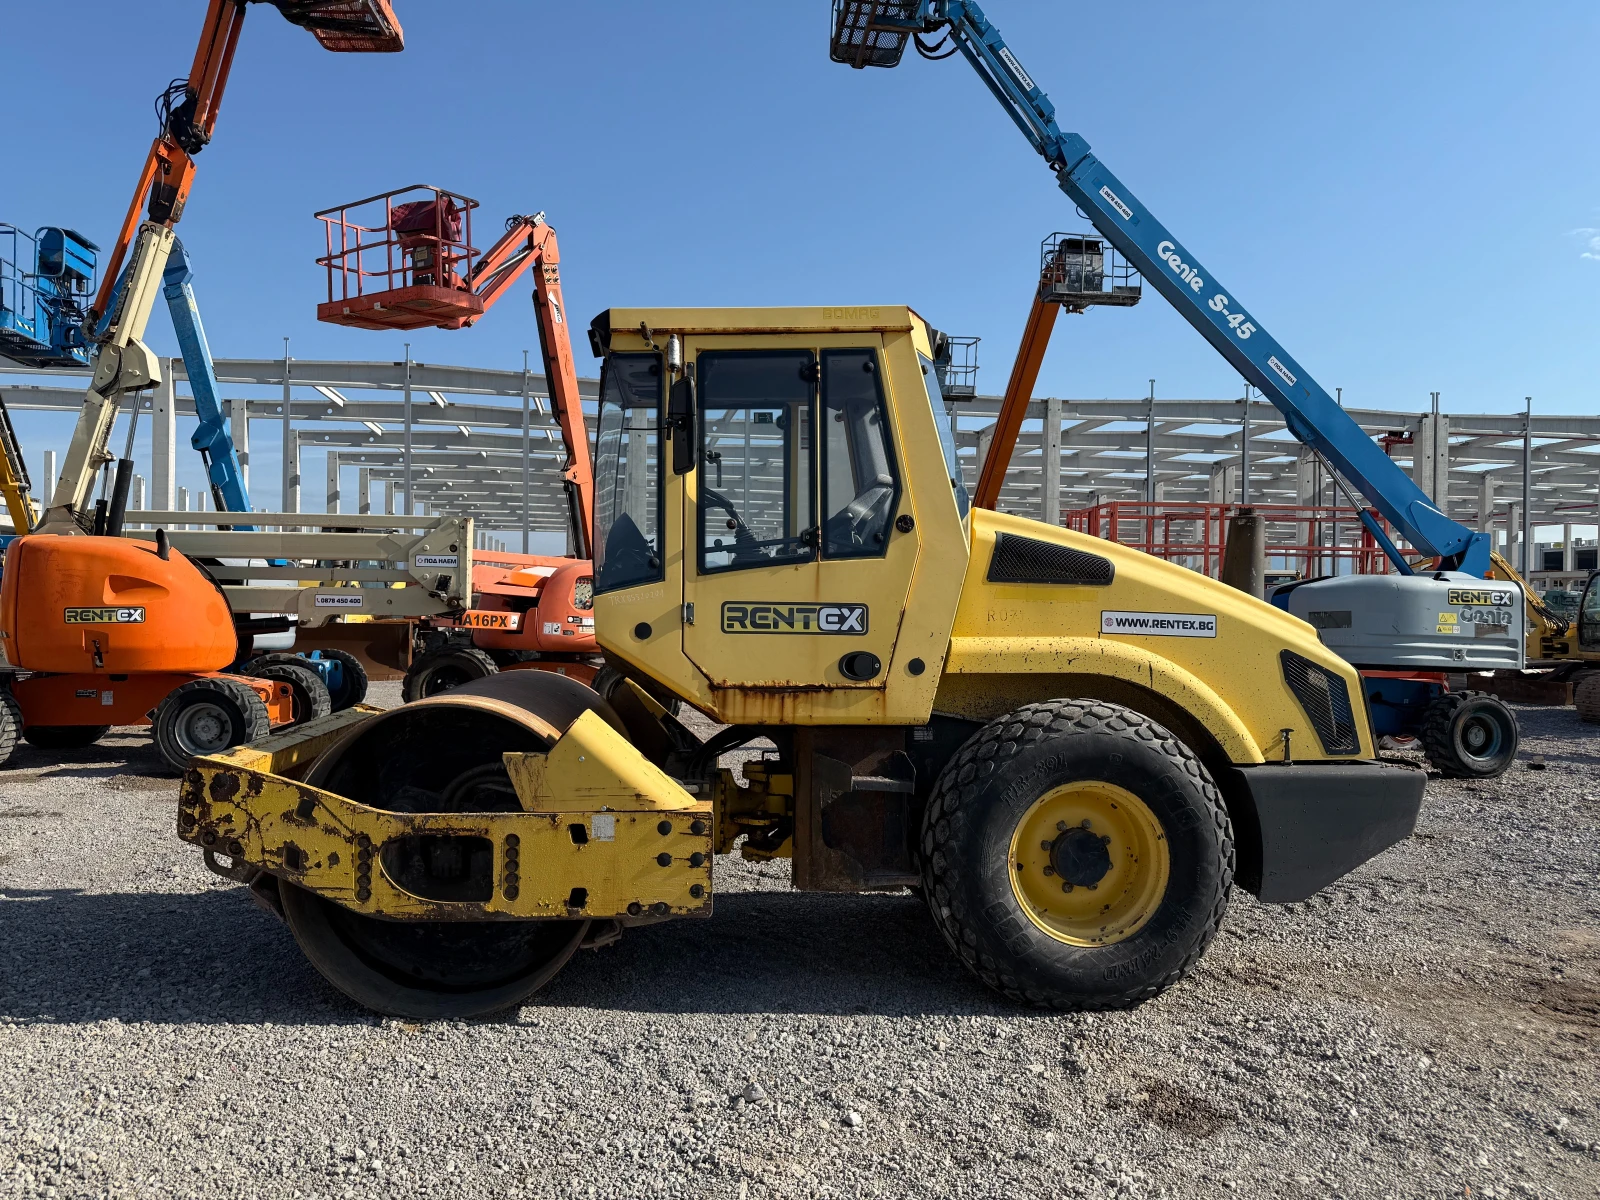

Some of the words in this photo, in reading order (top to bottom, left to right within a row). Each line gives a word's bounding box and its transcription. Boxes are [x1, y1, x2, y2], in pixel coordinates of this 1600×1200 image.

[1157, 240, 1204, 294] Genie
[1208, 293, 1257, 340] S-45
[822, 307, 881, 320] BOMAG
[1449, 590, 1512, 605] RENTEX
[66, 609, 143, 622] RENTEX
[452, 613, 508, 628] HA16PX
[726, 606, 863, 631] RENTEX
[1459, 605, 1513, 625] Genie
[1115, 616, 1214, 631] WWW.RENTEX.BG
